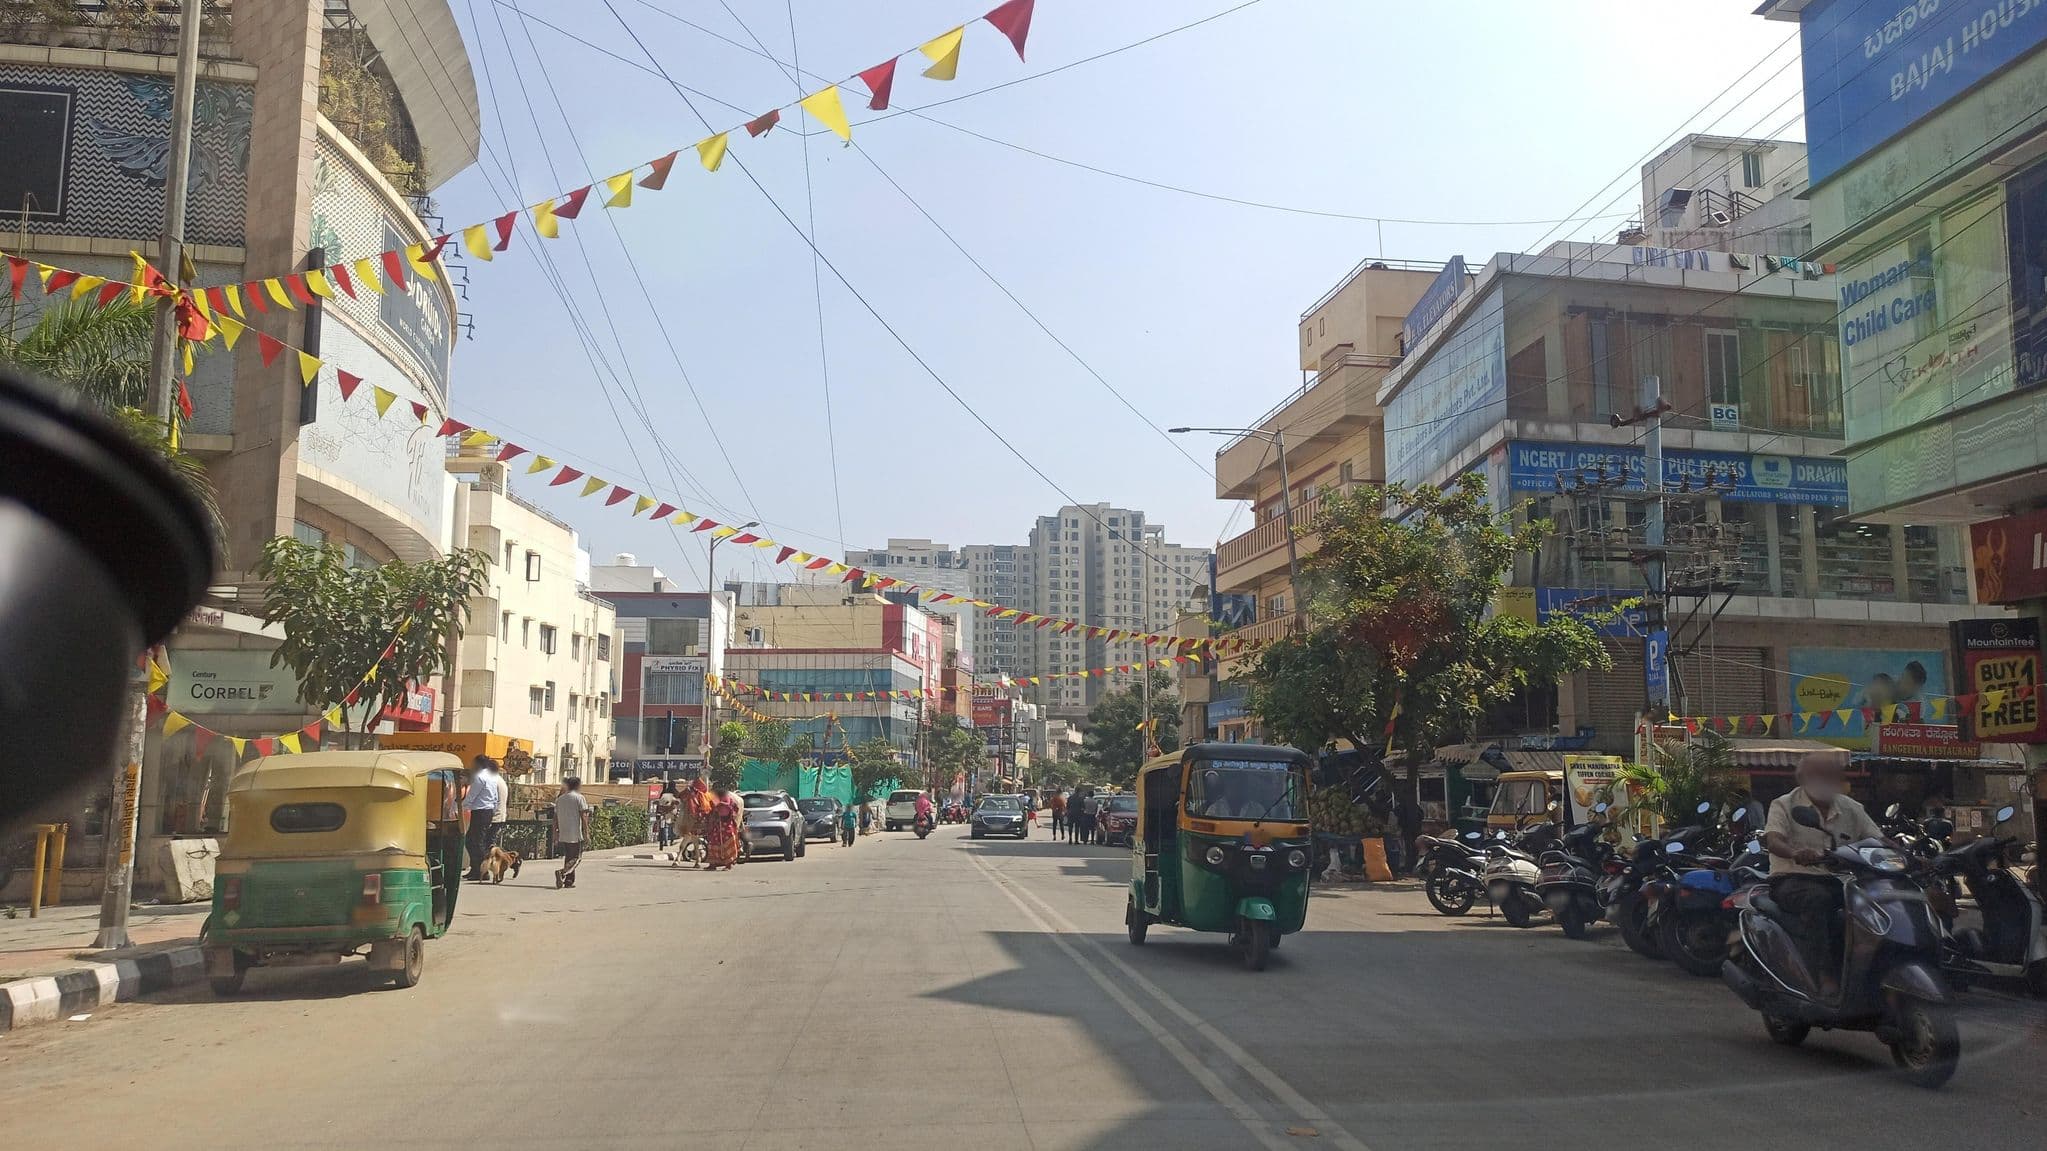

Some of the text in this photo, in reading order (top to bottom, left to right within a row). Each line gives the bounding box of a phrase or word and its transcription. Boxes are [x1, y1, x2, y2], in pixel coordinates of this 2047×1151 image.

[1890, 36, 1953, 101] BAJAJ
[1840, 260, 1911, 307] Woman
[1843, 287, 1937, 347] Child Care
[1713, 407, 1738, 420] BG
[1519, 450, 1567, 469] NCERT
[1667, 457, 1697, 475] PUC
[1700, 459, 1747, 478] BOOKS
[1522, 480, 1547, 488] OFFICE
[1728, 488, 1772, 498] ALCULATORS
[1967, 636, 2035, 648] MountainTree
[1649, 640, 1659, 671] P
[192, 670, 217, 689] Century
[1980, 657, 2034, 686] BUY 1
[190, 683, 256, 700] CORBEL
[1981, 700, 2037, 728] FREE
[1882, 744, 1978, 757] SANGEETHA RESTAURANT
